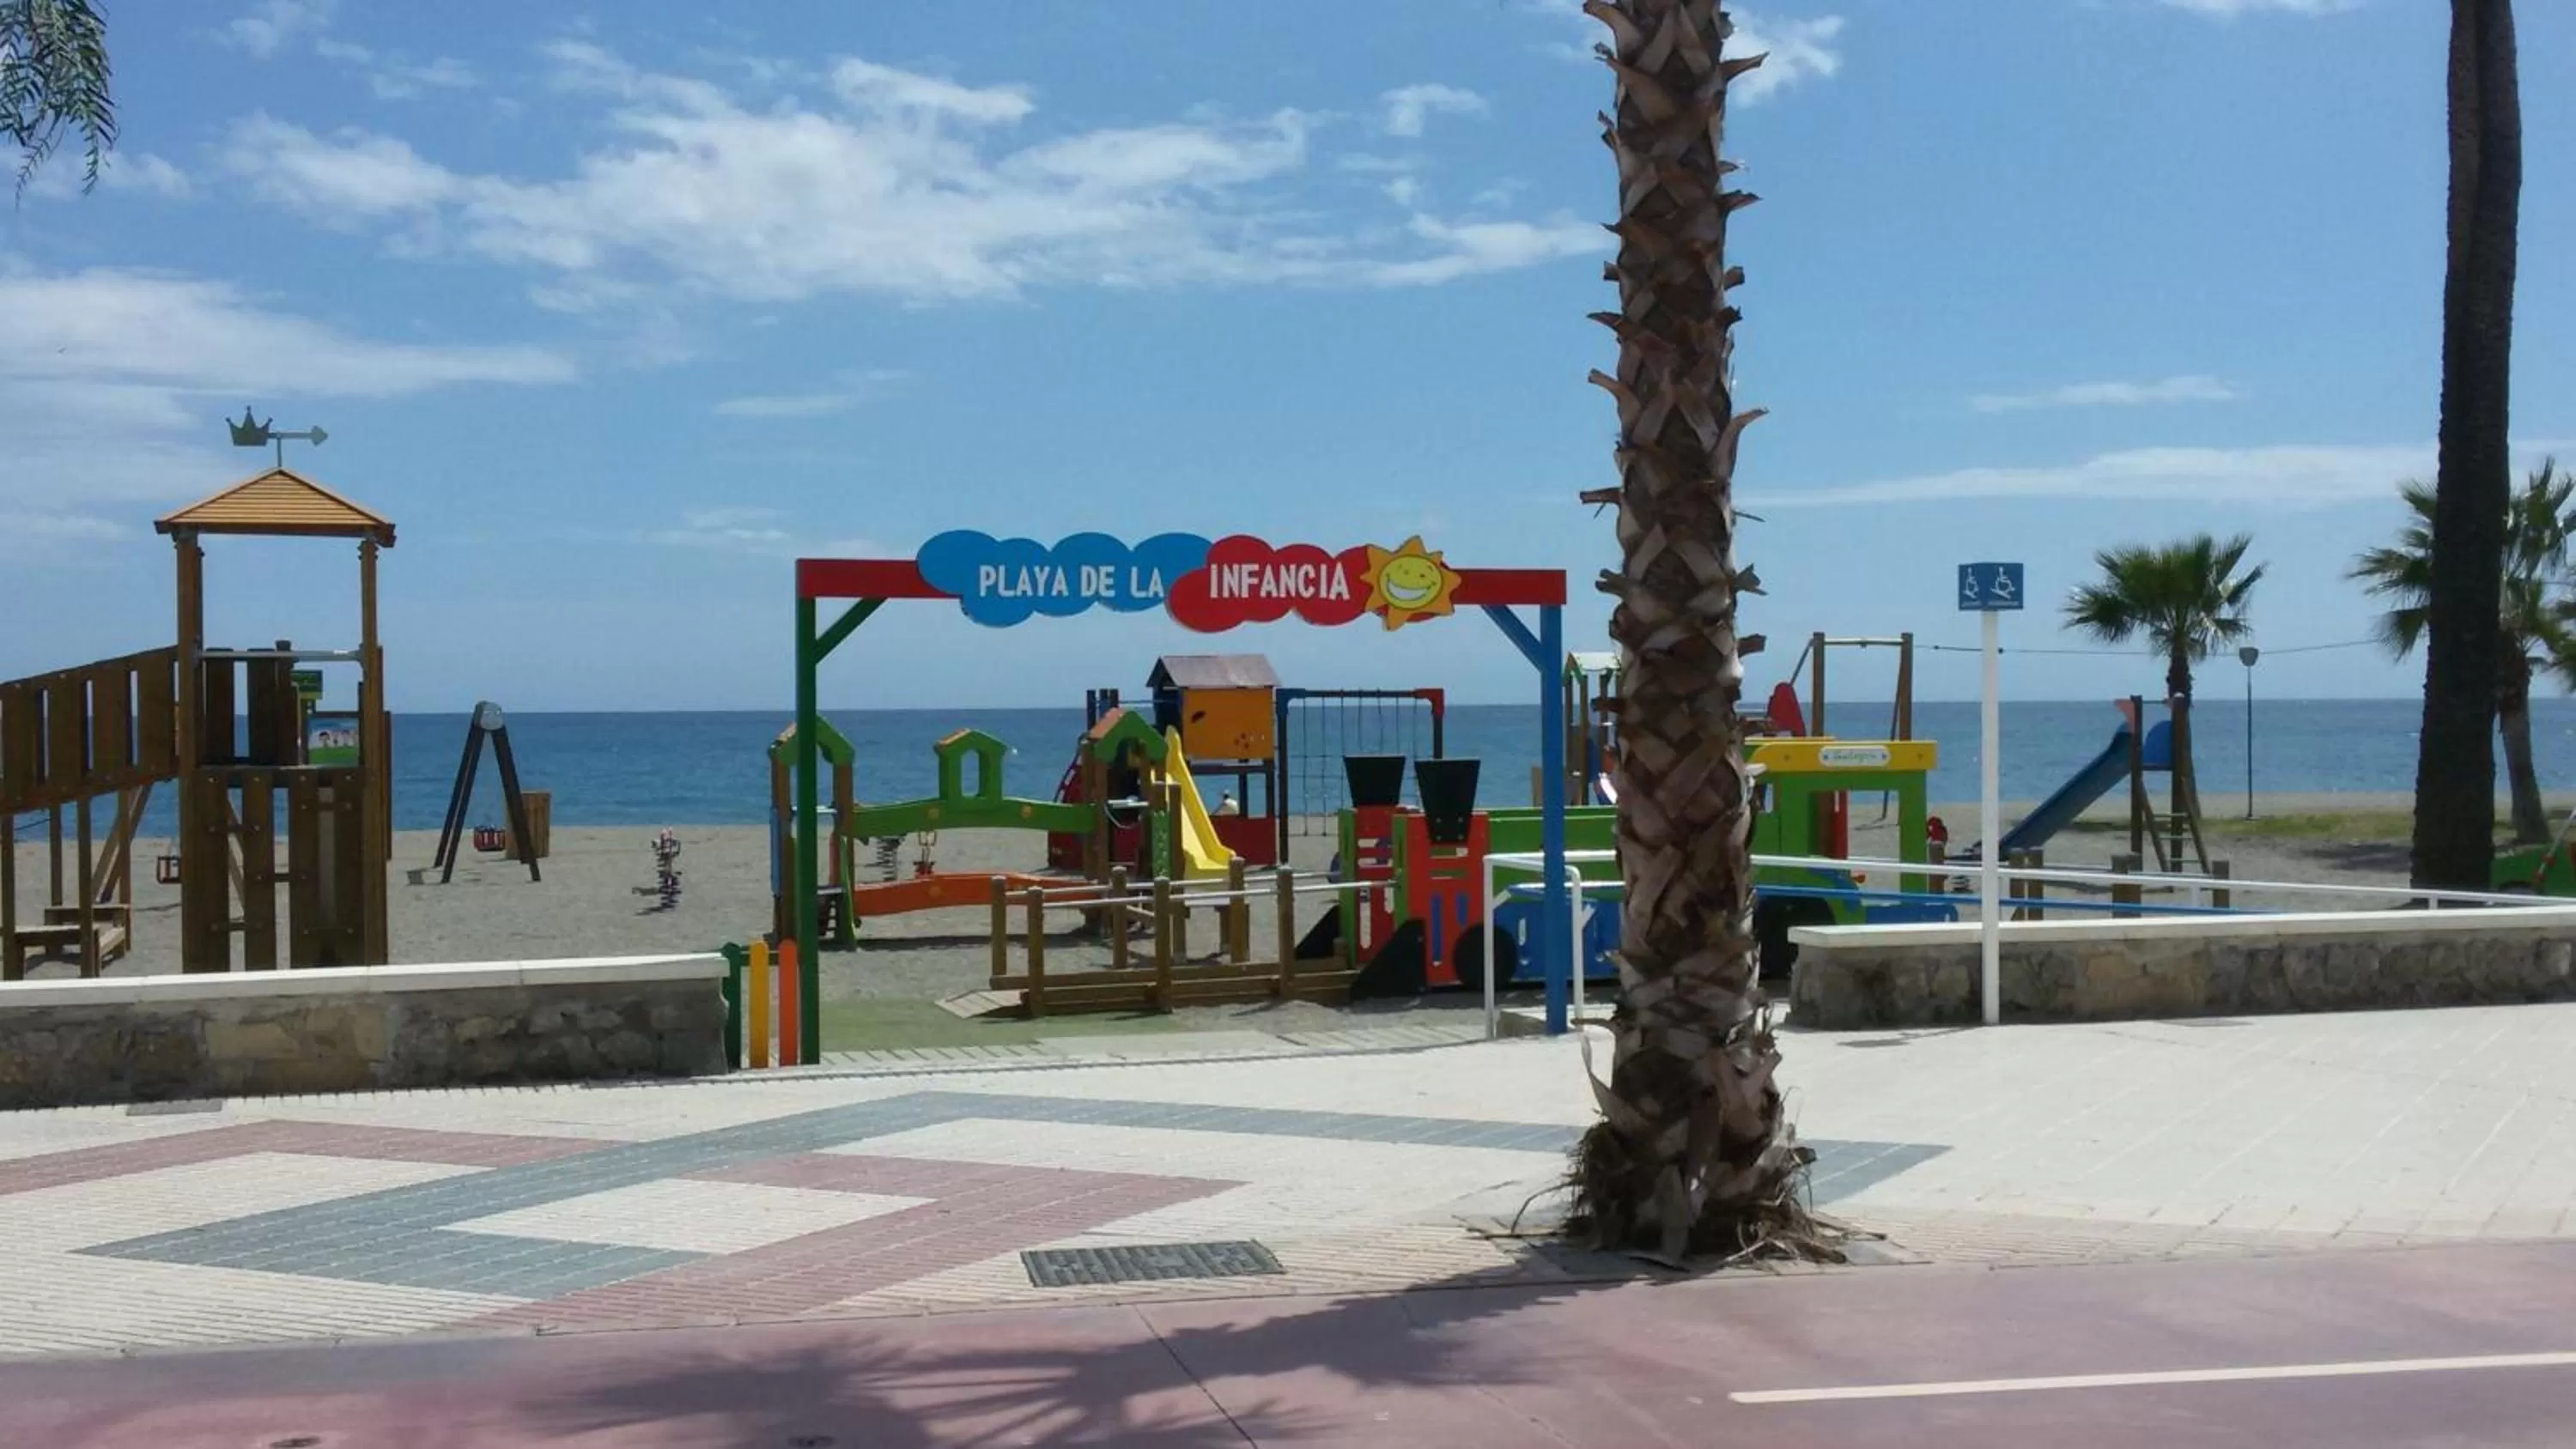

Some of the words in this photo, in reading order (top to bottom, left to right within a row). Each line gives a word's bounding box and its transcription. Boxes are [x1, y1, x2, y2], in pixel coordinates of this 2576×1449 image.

[979, 565, 1069, 597] PLAYA
[1080, 566, 1115, 597] DE
[1130, 567, 1164, 598] LA
[1209, 562, 1351, 600] INFANCIA
